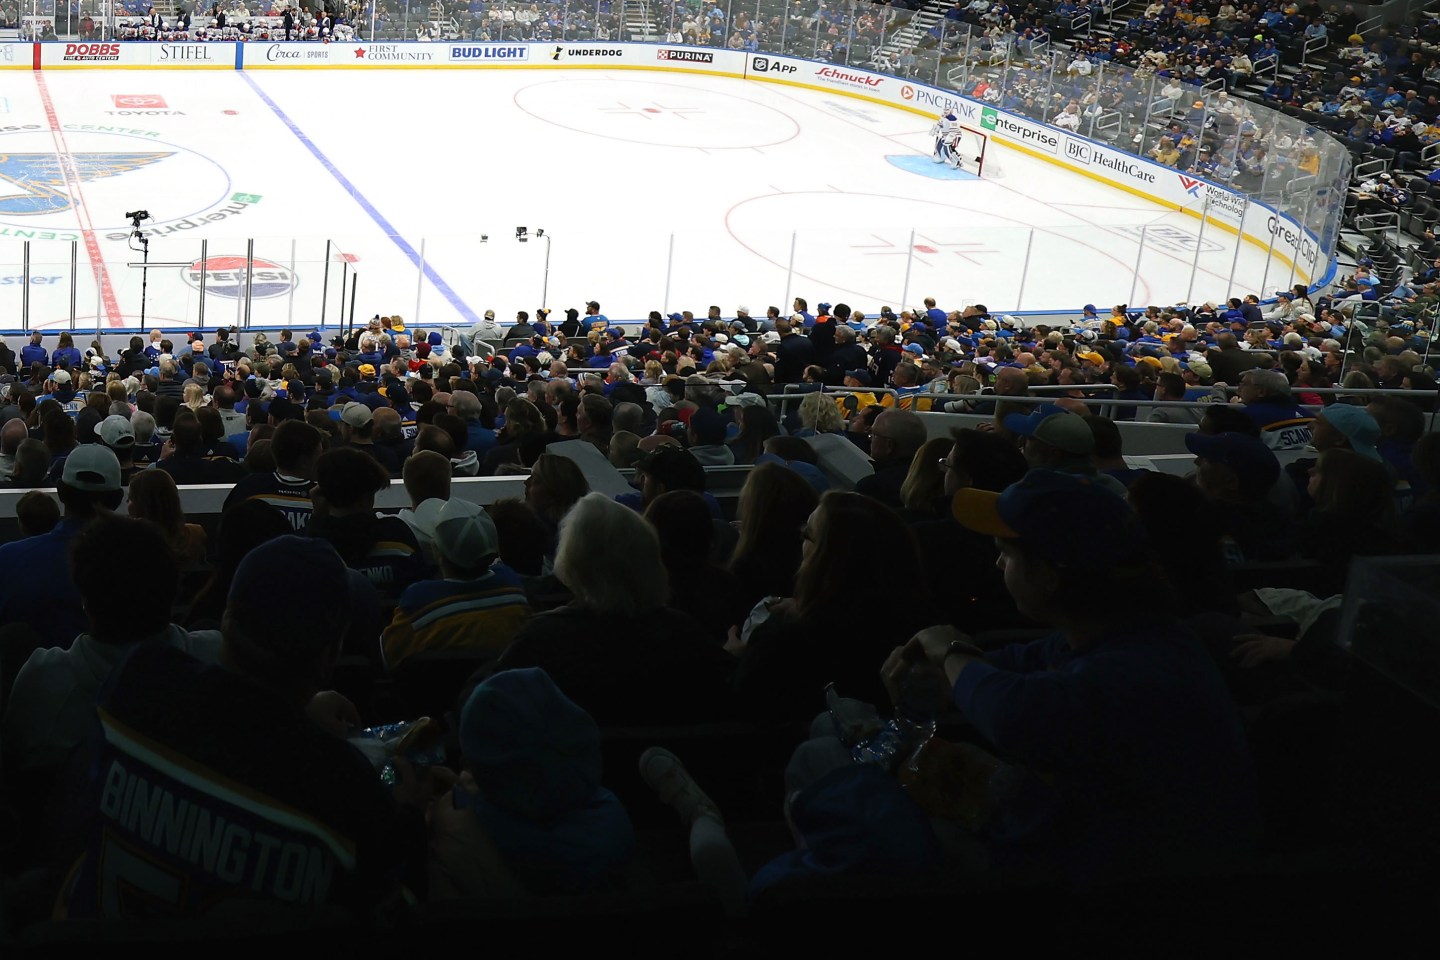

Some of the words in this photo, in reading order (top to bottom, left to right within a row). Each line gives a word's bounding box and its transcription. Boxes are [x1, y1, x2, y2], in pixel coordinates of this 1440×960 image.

[65, 44, 120, 55] DOBBS
[160, 43, 211, 60] STIFEL
[266, 43, 301, 61] Circa
[307, 50, 329, 58] SPORTS
[368, 52, 434, 61] COMMUNITY
[452, 47, 482, 58] BUD
[485, 47, 526, 58] LIGHT
[568, 49, 623, 57] UNDERDOG
[670, 51, 711, 62] PURINA
[815, 67, 884, 87] Schnucks
[916, 89, 944, 108] PNC
[944, 98, 976, 119] BANK
[63, 123, 160, 137] CENTER
[981, 110, 1058, 148] enterprise
[1068, 142, 1089, 160] BJC
[1093, 151, 1156, 184] HealthCare
[100, 759, 334, 906] BINNINGTON
